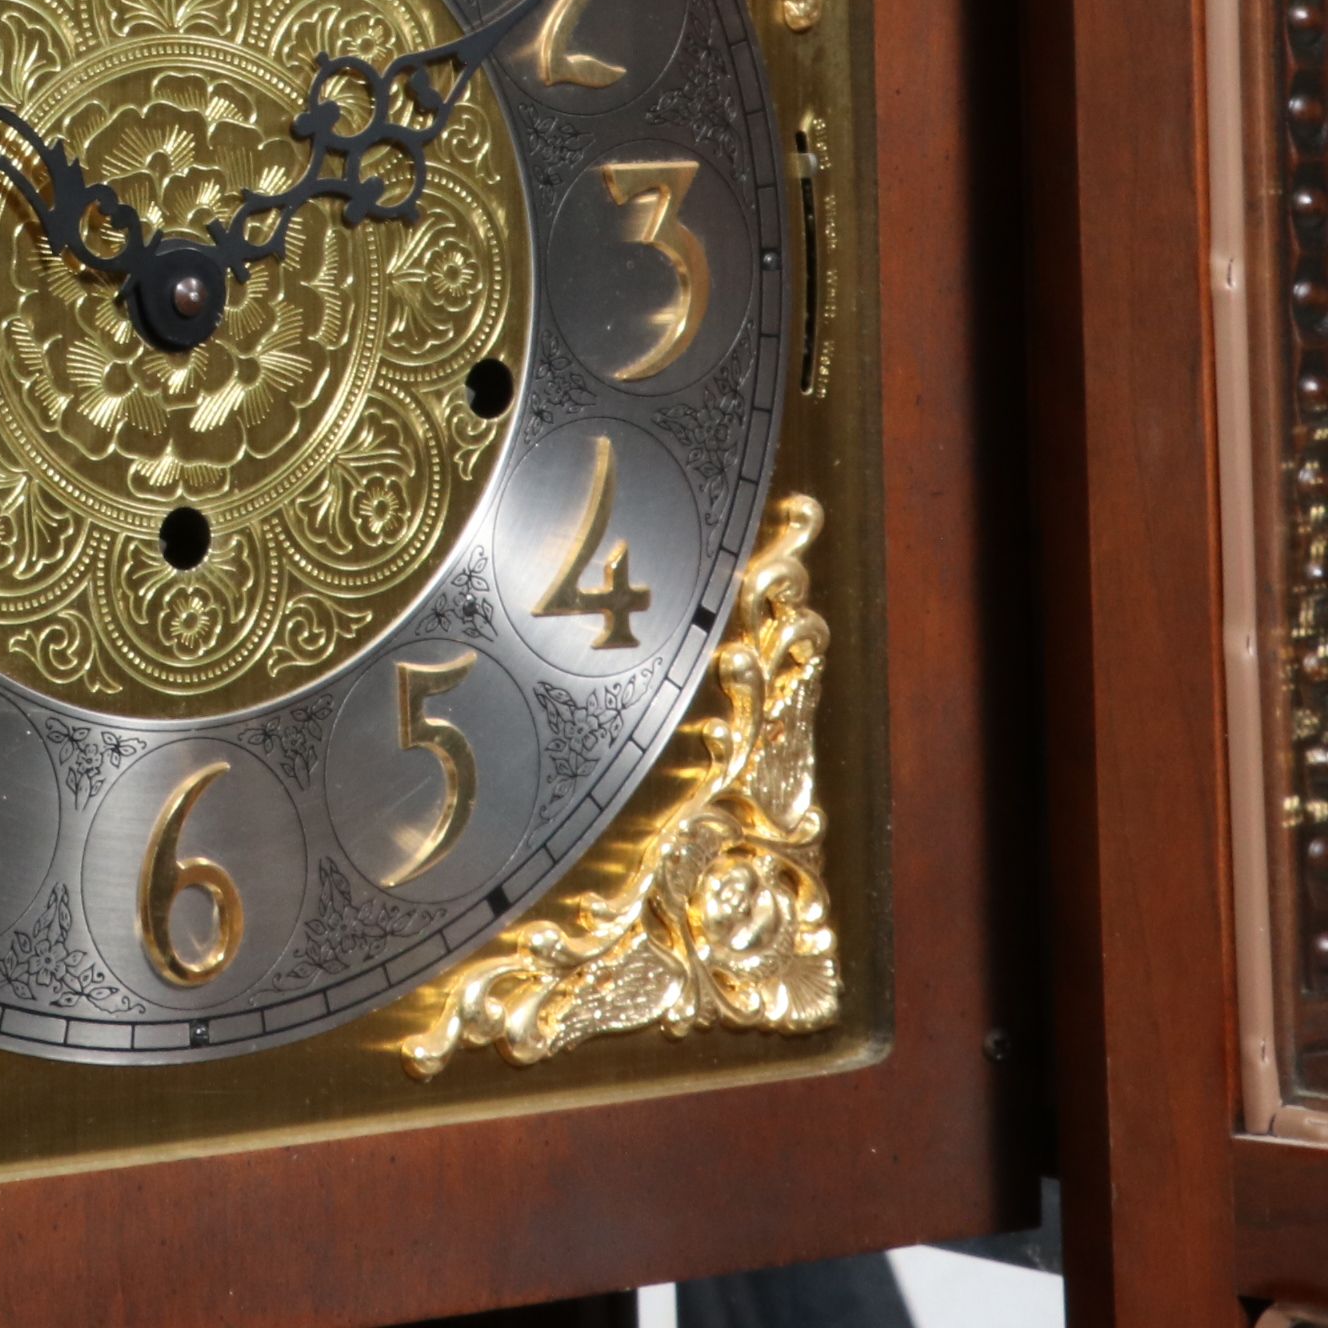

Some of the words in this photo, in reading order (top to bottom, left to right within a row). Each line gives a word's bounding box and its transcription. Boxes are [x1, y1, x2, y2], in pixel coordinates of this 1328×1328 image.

[604, 161, 711, 382] 3
[531, 437, 650, 650] 4
[138, 762, 245, 988] 6
[380, 650, 477, 887] 5
